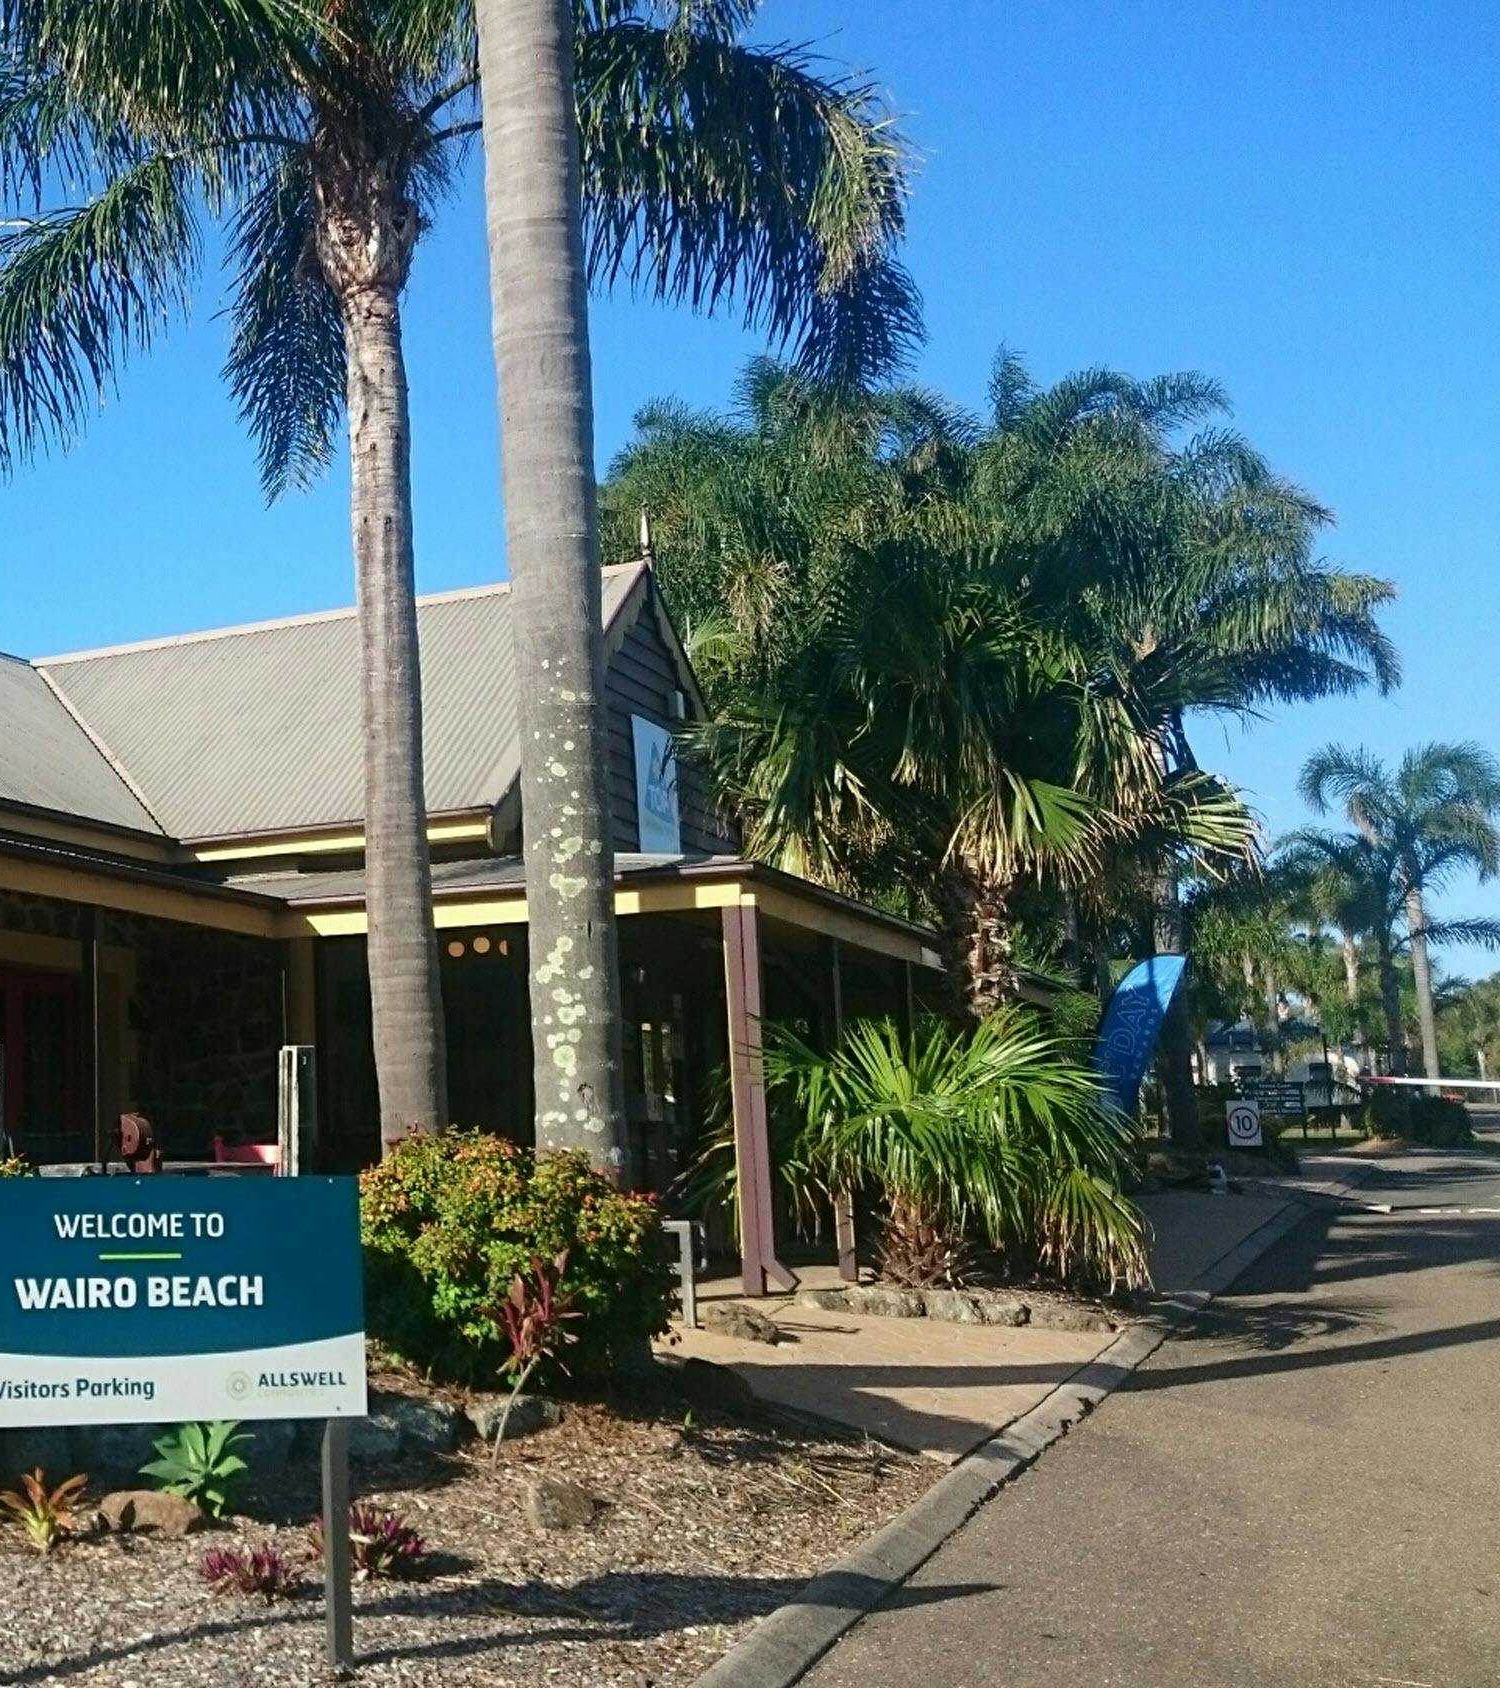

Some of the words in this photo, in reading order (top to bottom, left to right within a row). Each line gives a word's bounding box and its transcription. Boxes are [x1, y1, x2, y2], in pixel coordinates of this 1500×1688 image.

[1235, 1115, 1253, 1131] 10
[54, 1213, 184, 1238] WELCOME
[190, 1213, 225, 1237] TO
[14, 1278, 137, 1310] WAIRO
[147, 1275, 264, 1308] BEACH
[75, 1377, 155, 1400] Parking
[258, 1371, 347, 1387] ALLSWELL
